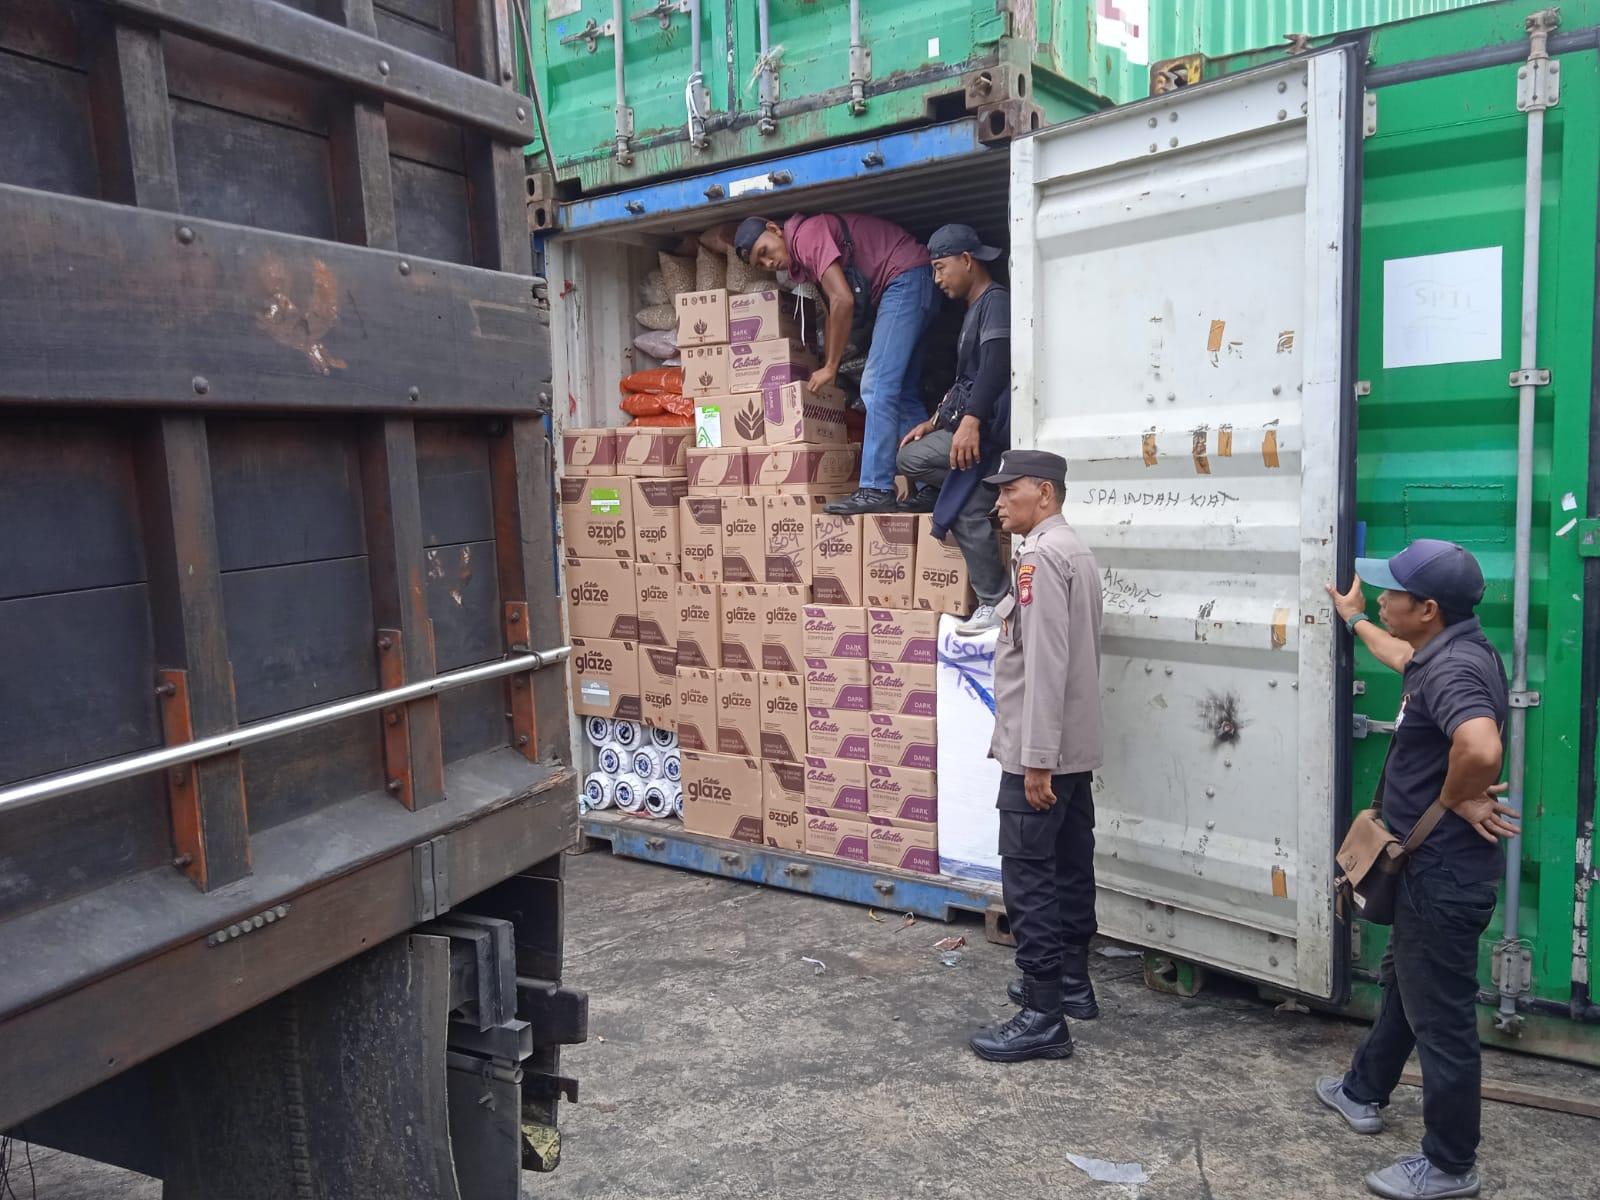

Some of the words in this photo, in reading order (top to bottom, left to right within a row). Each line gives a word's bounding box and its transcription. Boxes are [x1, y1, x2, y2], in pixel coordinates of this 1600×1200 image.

[1083, 488, 1117, 505] SPA
[587, 520, 626, 543] glaze
[640, 526, 667, 541] glaze
[726, 521, 756, 537] glaze
[771, 520, 804, 536] glaze
[685, 544, 714, 559] glaze
[820, 540, 852, 556] glaze
[922, 570, 959, 587] glaze
[571, 585, 609, 606] glaze
[641, 588, 668, 602] glaze
[680, 606, 710, 622] glaze
[726, 608, 756, 624] glaze
[766, 608, 797, 624] glaze
[805, 620, 836, 631] Colatta
[871, 623, 904, 636] Colatta
[575, 653, 612, 674] glaze
[807, 671, 838, 683] Colatta
[872, 675, 904, 688] Colatta
[645, 693, 672, 707] glaze
[680, 690, 708, 705] glaze
[722, 693, 751, 709] glaze
[767, 698, 798, 713] glaze
[809, 720, 840, 733] Colatta
[871, 727, 903, 740] Colatta
[688, 779, 732, 801] glaze
[870, 778, 902, 792] Colatta
[845, 797, 862, 805] DARK
[768, 811, 799, 826] glaze
[911, 807, 928, 815] DARK
[870, 828, 904, 843] Colatta
[847, 846, 864, 854] DARK
[913, 858, 930, 866] DARK
